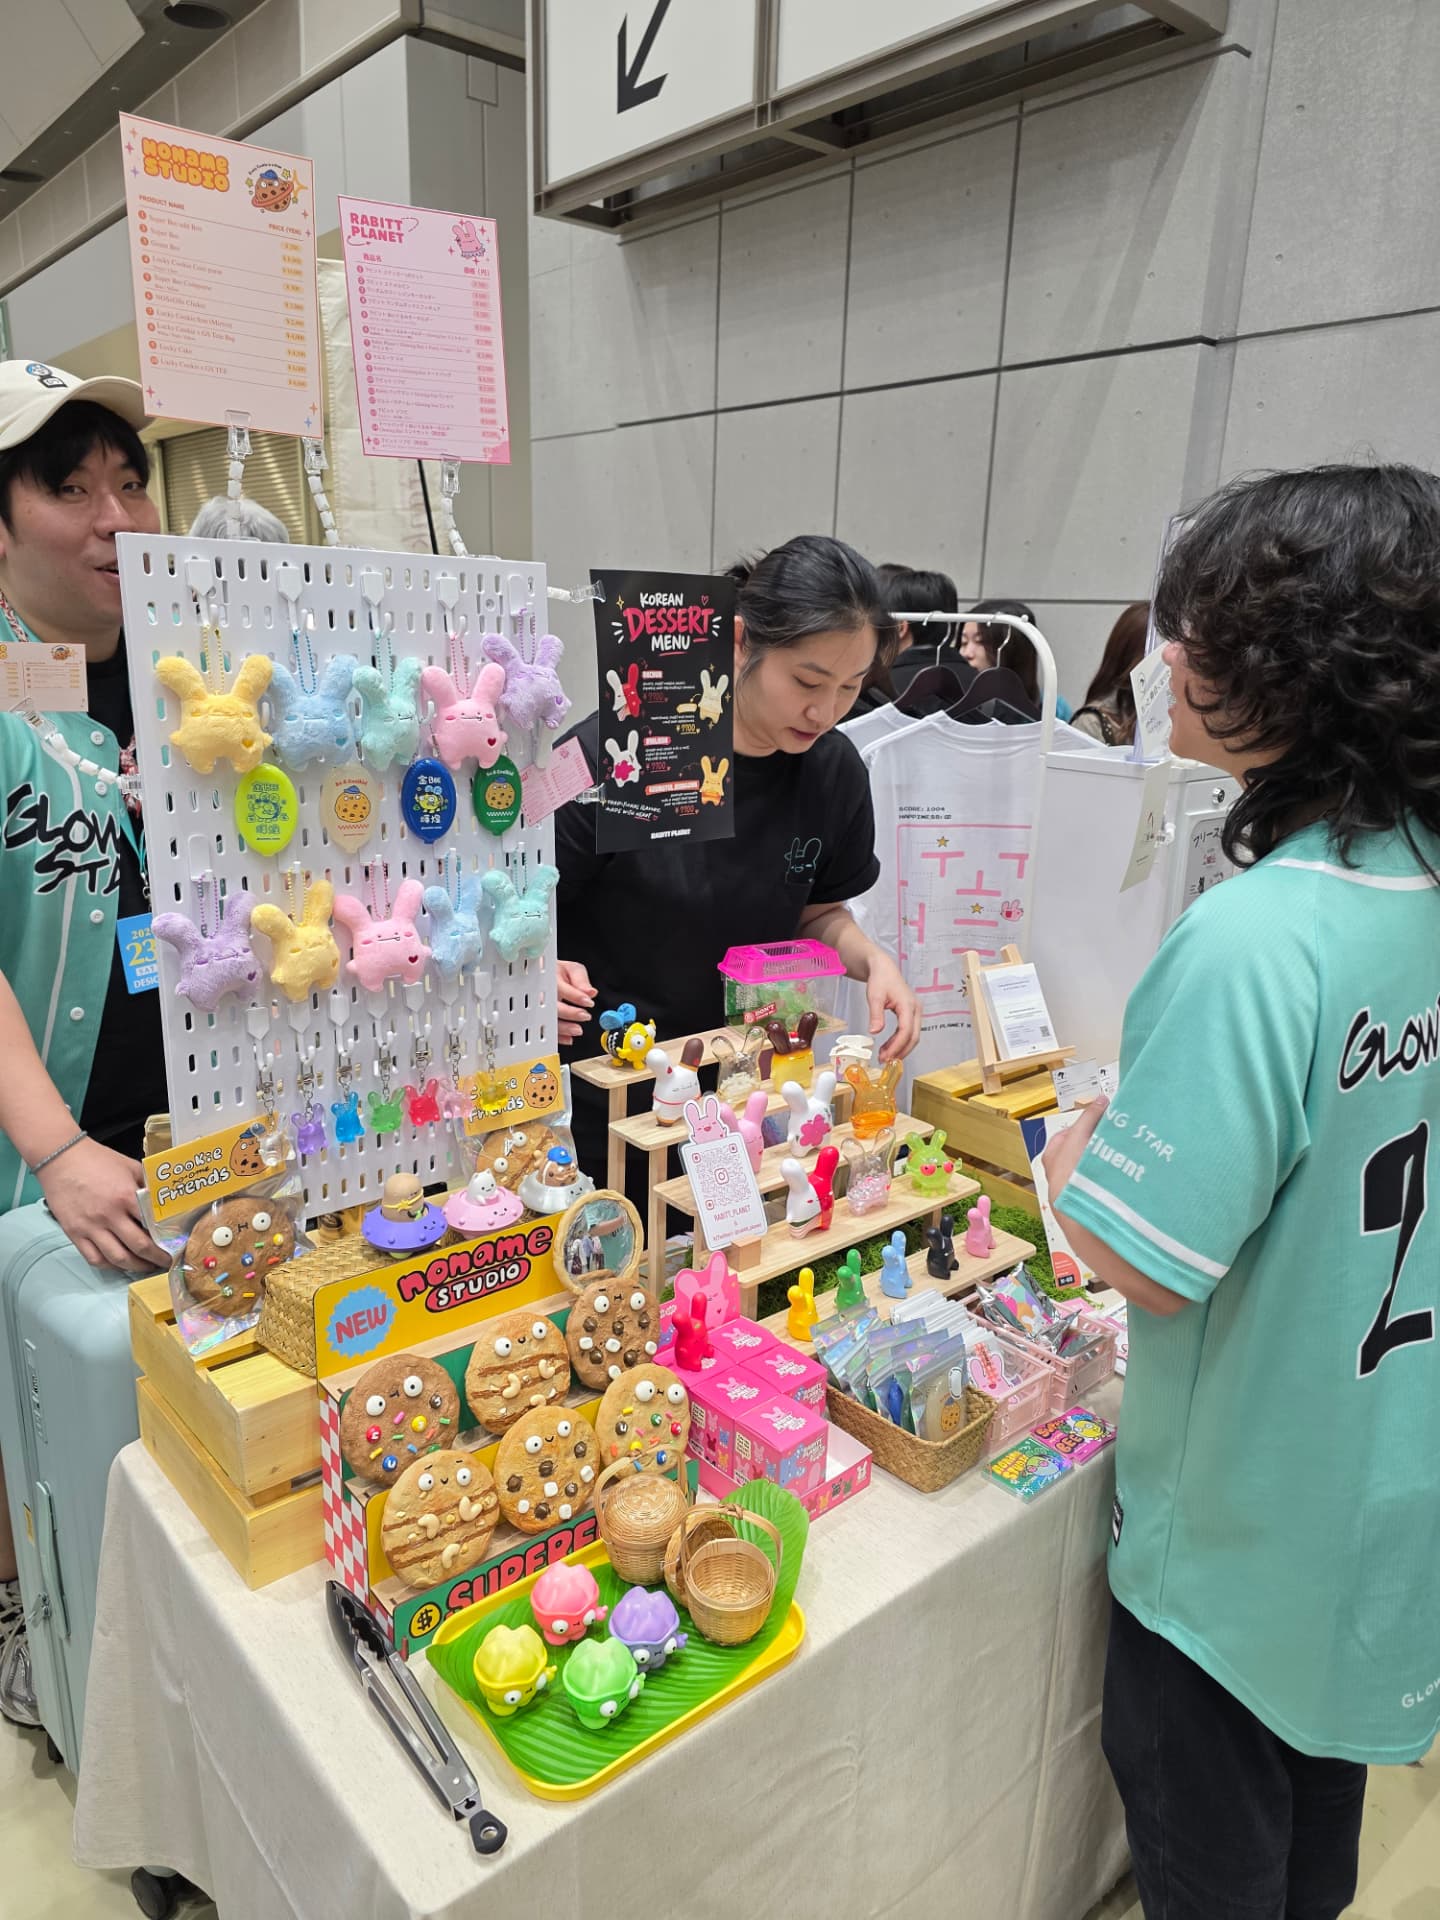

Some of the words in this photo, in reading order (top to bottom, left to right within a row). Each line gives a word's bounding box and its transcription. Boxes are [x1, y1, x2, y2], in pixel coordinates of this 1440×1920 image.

[144, 156, 230, 193] STUDIO
[350, 212, 403, 231] RABITT
[351, 225, 405, 244] PLANET
[640, 592, 683, 608] KOREAN
[623, 605, 714, 642] DESSERT
[651, 634, 690, 652] MENU
[605, 806, 621, 814] MADE
[635, 811, 652, 819] HEART
[131, 927, 153, 940] 202
[126, 938, 159, 967] 23
[1337, 990, 1440, 1094] GLOW
[1132, 1124, 1176, 1162] STAR
[157, 1147, 223, 1181] Cookie
[157, 1167, 231, 1206] Friends
[397, 1226, 553, 1303] noname
[1356, 1119, 1435, 1380] 2
[437, 1263, 520, 1307] STUDIO
[335, 1303, 387, 1344] NEW
[445, 1514, 600, 1612] SUPERE
